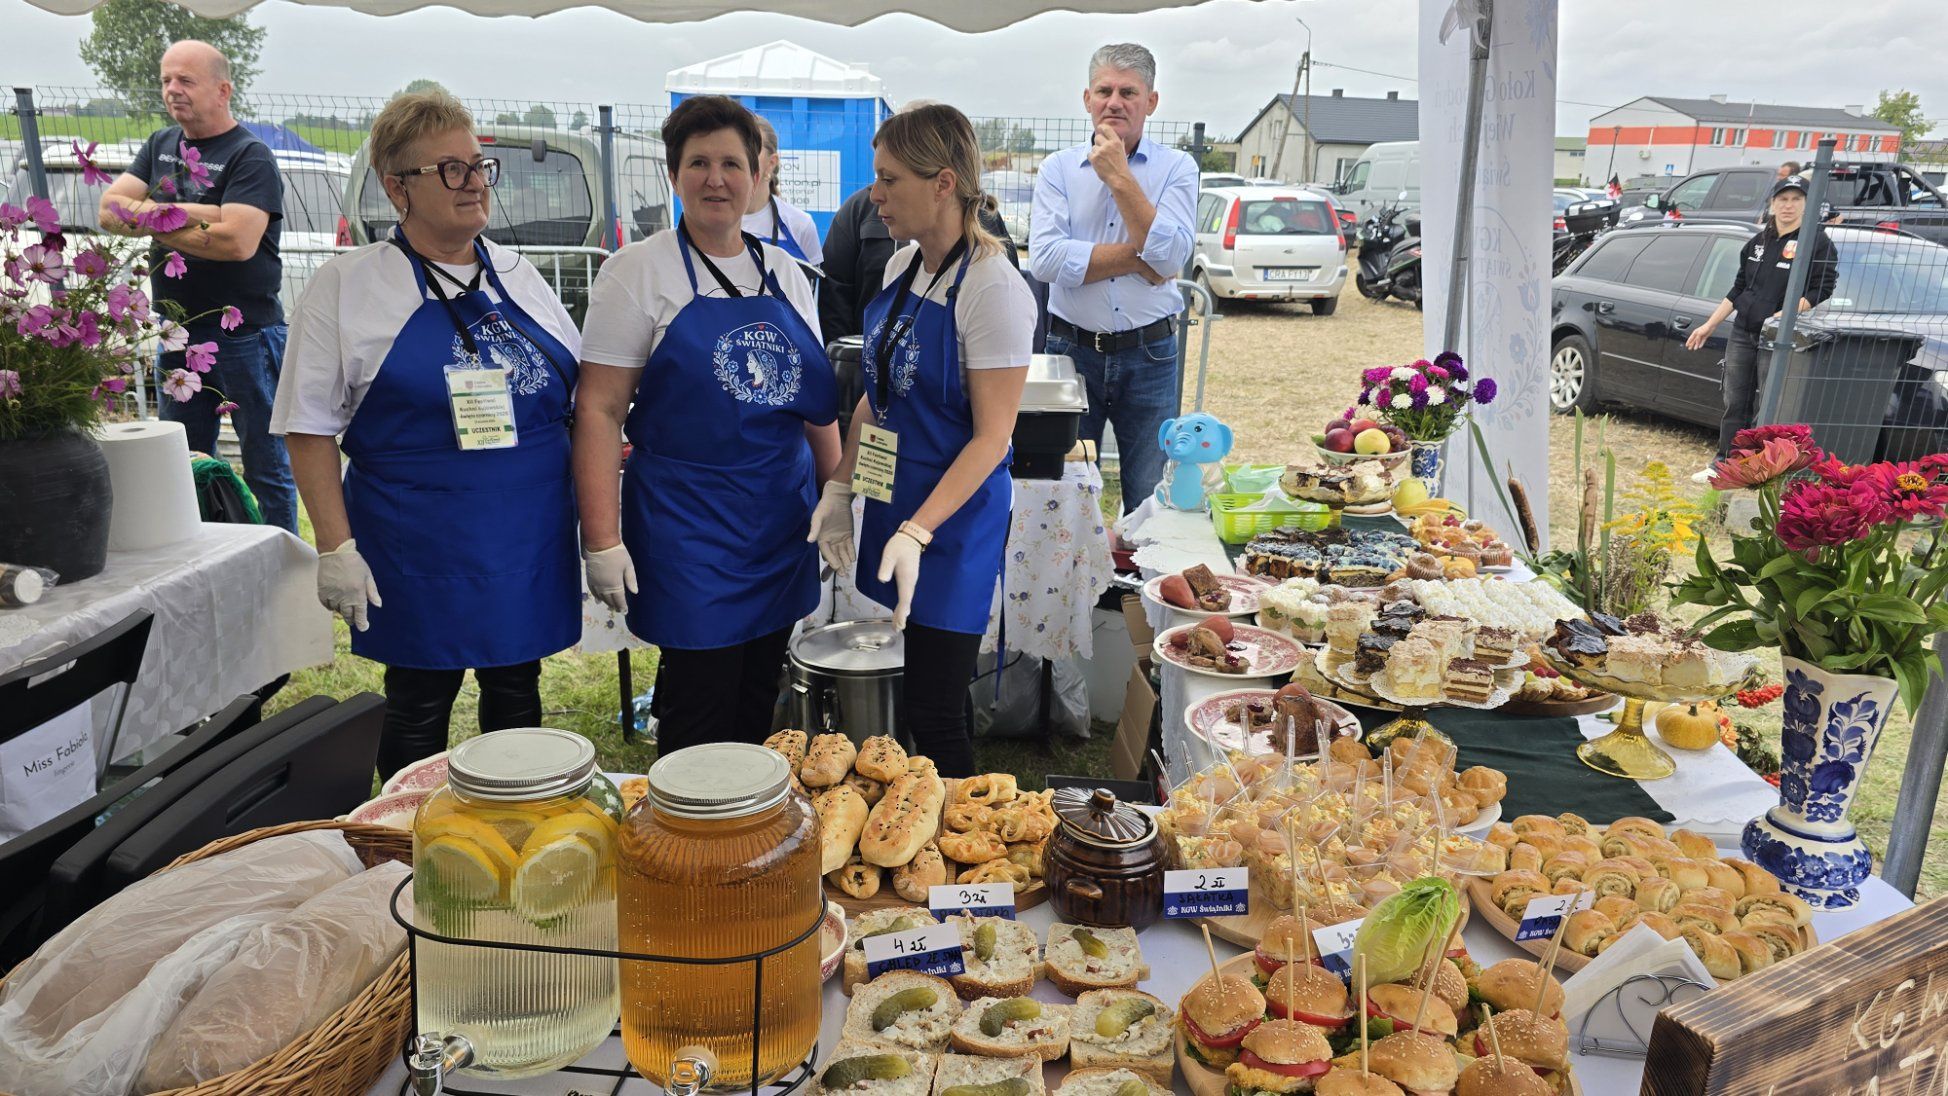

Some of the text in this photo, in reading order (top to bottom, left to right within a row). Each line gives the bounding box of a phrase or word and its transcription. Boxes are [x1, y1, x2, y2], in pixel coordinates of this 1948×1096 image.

[481, 320, 512, 336] KGW
[744, 330, 778, 342] KGW
[736, 338, 785, 354] ŚWIĄTNIKI
[23, 731, 89, 777] Miss Fabiola
[1194, 874, 1208, 891] 2
[1180, 905, 1198, 914] KGW
[1554, 899, 1566, 911] 2
[894, 937, 904, 954] 4
